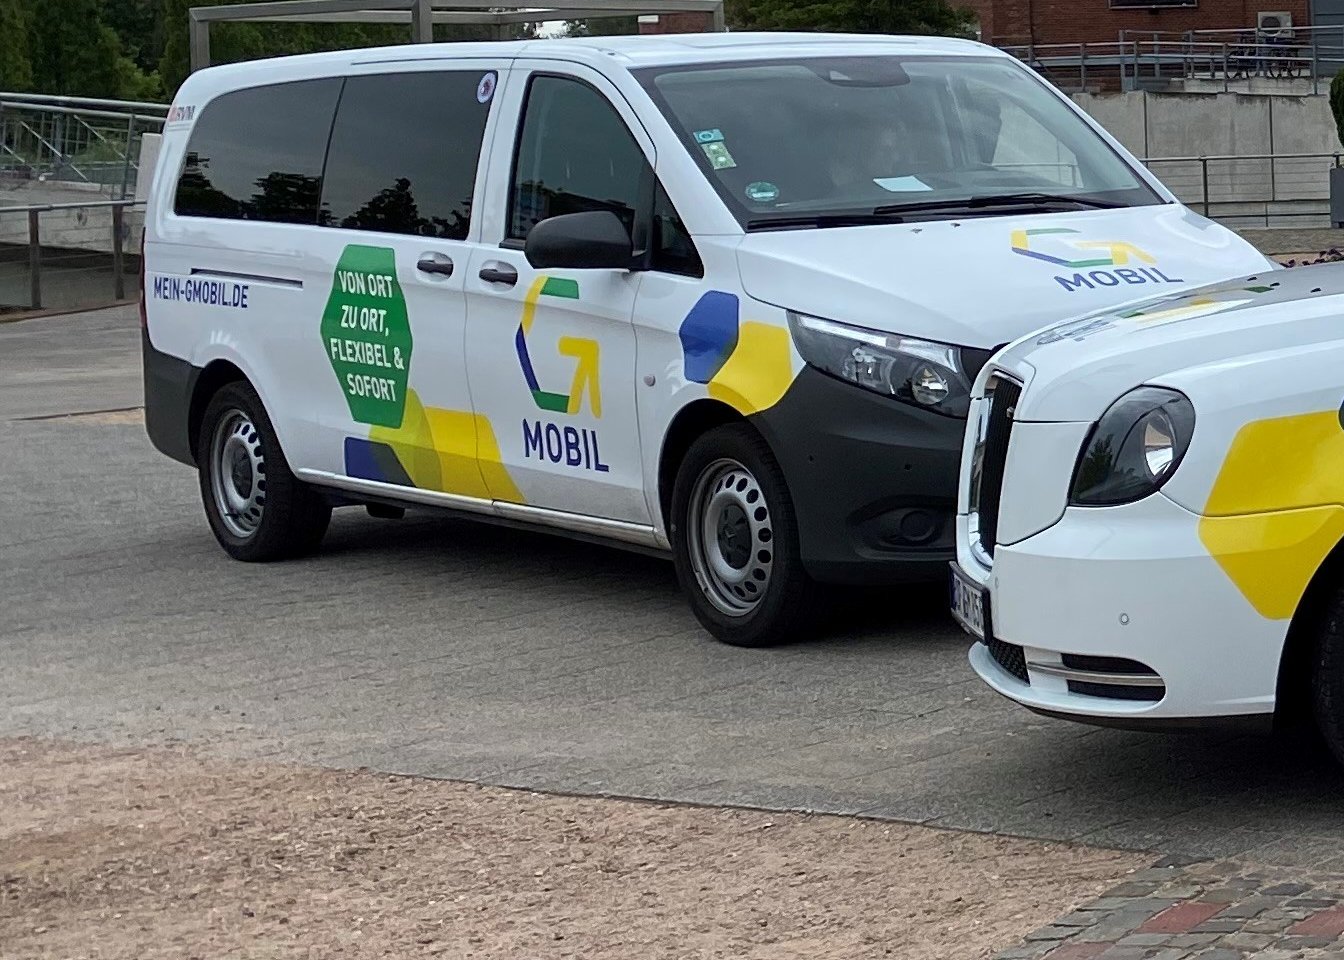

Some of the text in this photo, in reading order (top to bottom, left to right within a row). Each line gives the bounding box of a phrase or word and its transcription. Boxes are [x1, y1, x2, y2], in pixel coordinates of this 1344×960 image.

[153, 276, 249, 309] MEIN-GMOBIL.DE
[338, 270, 393, 299] VON ORT
[1053, 267, 1185, 292] MOBIL
[340, 304, 390, 337] ZU ORT,
[330, 337, 405, 370] FLEXIBEL &
[346, 373, 397, 402] SOFORT
[522, 418, 610, 473] MOBIL
